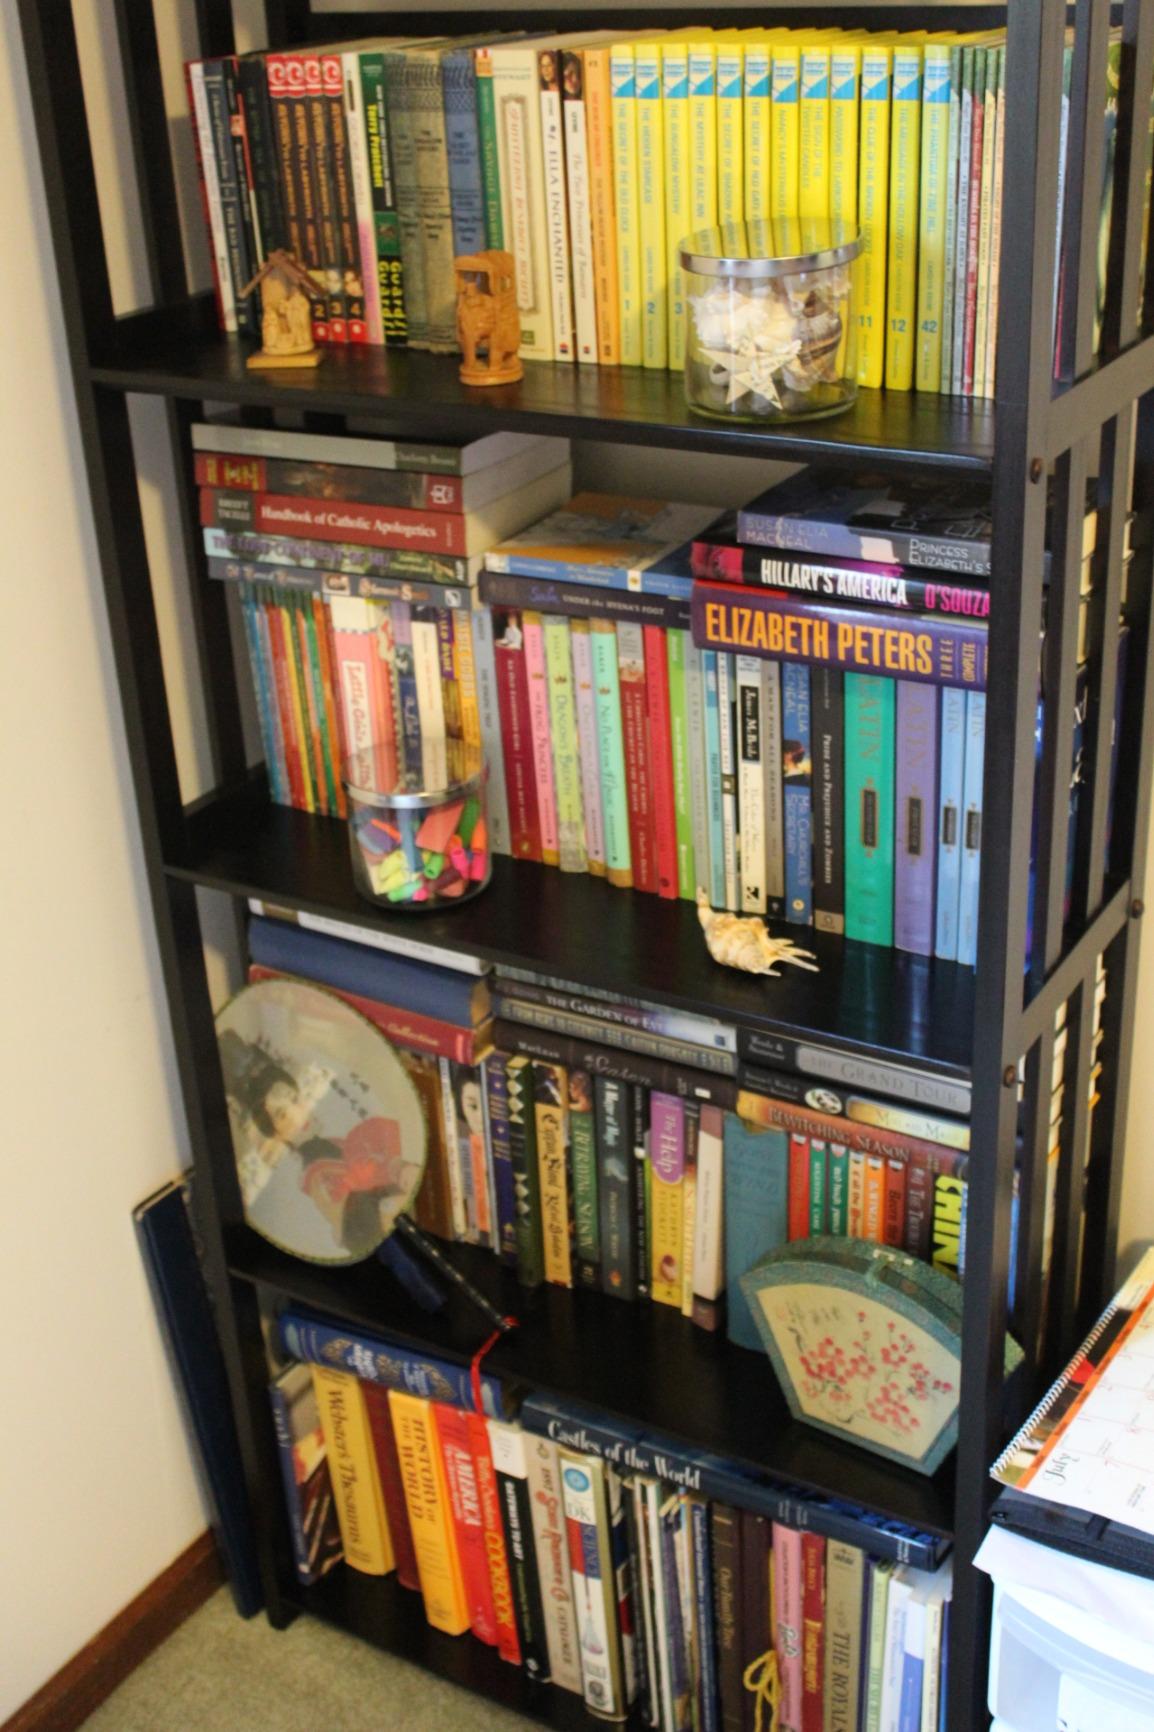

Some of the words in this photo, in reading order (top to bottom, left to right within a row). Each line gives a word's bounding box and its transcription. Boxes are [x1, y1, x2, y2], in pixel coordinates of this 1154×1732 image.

[367, 105, 378, 133] Terry
[370, 135, 383, 188] Pratchett
[548, 150, 560, 186] ELLA
[549, 191, 565, 284] ENCHANTED
[647, 302, 655, 314] 2
[859, 315, 873, 328] 11
[891, 319, 906, 333] 12
[922, 319, 938, 334] 42
[261, 504, 312, 525] Handbook
[314, 513, 326, 526] of
[328, 513, 371, 531] Catholic
[374, 519, 438, 540] Apologetics
[746, 517, 793, 534] SUSAN
[908, 538, 969, 559] PRINCESS
[908, 550, 984, 577] ELIZABETH'S
[562, 594, 591, 605] UNDER
[606, 601, 641, 613] HYENA'S
[642, 606, 665, 616] FOOT
[760, 558, 837, 595] HILLARY'S
[838, 569, 908, 606] AMERICA
[925, 585, 990, 617] D'SOUZA
[705, 602, 830, 660] ELIZABETH
[837, 622, 933, 675] PETERS
[940, 638, 954, 679] THREE
[961, 642, 977, 682] COMPLETE
[745, 689, 756, 717] James
[857, 676, 884, 760] LATIN
[972, 691, 985, 737] LATIN
[745, 717, 758, 758] McBride
[822, 734, 833, 760] PRIDE
[824, 762, 832, 780] AND
[823, 781, 833, 826] PREJUDICE
[786, 793, 799, 857] SECRETARY
[824, 828, 833, 846] AND
[823, 847, 833, 884] ZOMBIES
[546, 994, 568, 1008] THE
[569, 999, 622, 1021] GARDEN
[624, 1015, 639, 1025] OF
[604, 1082, 617, 1090] A
[841, 1061, 904, 1090] GRAND
[912, 1081, 958, 1107] TOUR
[664, 1114, 677, 1132] The
[768, 1105, 851, 1144] BEWITCHING
[855, 1133, 911, 1162] SEASON
[655, 1134, 678, 1174] Help
[400, 1416, 411, 1441] THE
[327, 1390, 351, 1459] Webster's
[340, 1462, 361, 1545] Thesaurus
[412, 1419, 437, 1505] HISTORY
[547, 1419, 598, 1454] Castles
[604, 1441, 619, 1463] of
[619, 1444, 649, 1471] the
[653, 1455, 700, 1490] World
[1042, 1452, 1081, 1487] July
[401, 1444, 425, 1520] WORLD
[453, 1449, 482, 1527] AMERICA
[505, 1481, 518, 1530] GATEWAYS
[566, 1502, 592, 1520] DK
[510, 1531, 520, 1541] TO
[511, 1541, 524, 1560] ART
[583, 1524, 600, 1579] SCIENCE
[484, 1530, 513, 1627] COOKBOOK
[831, 1631, 852, 1669] THE
